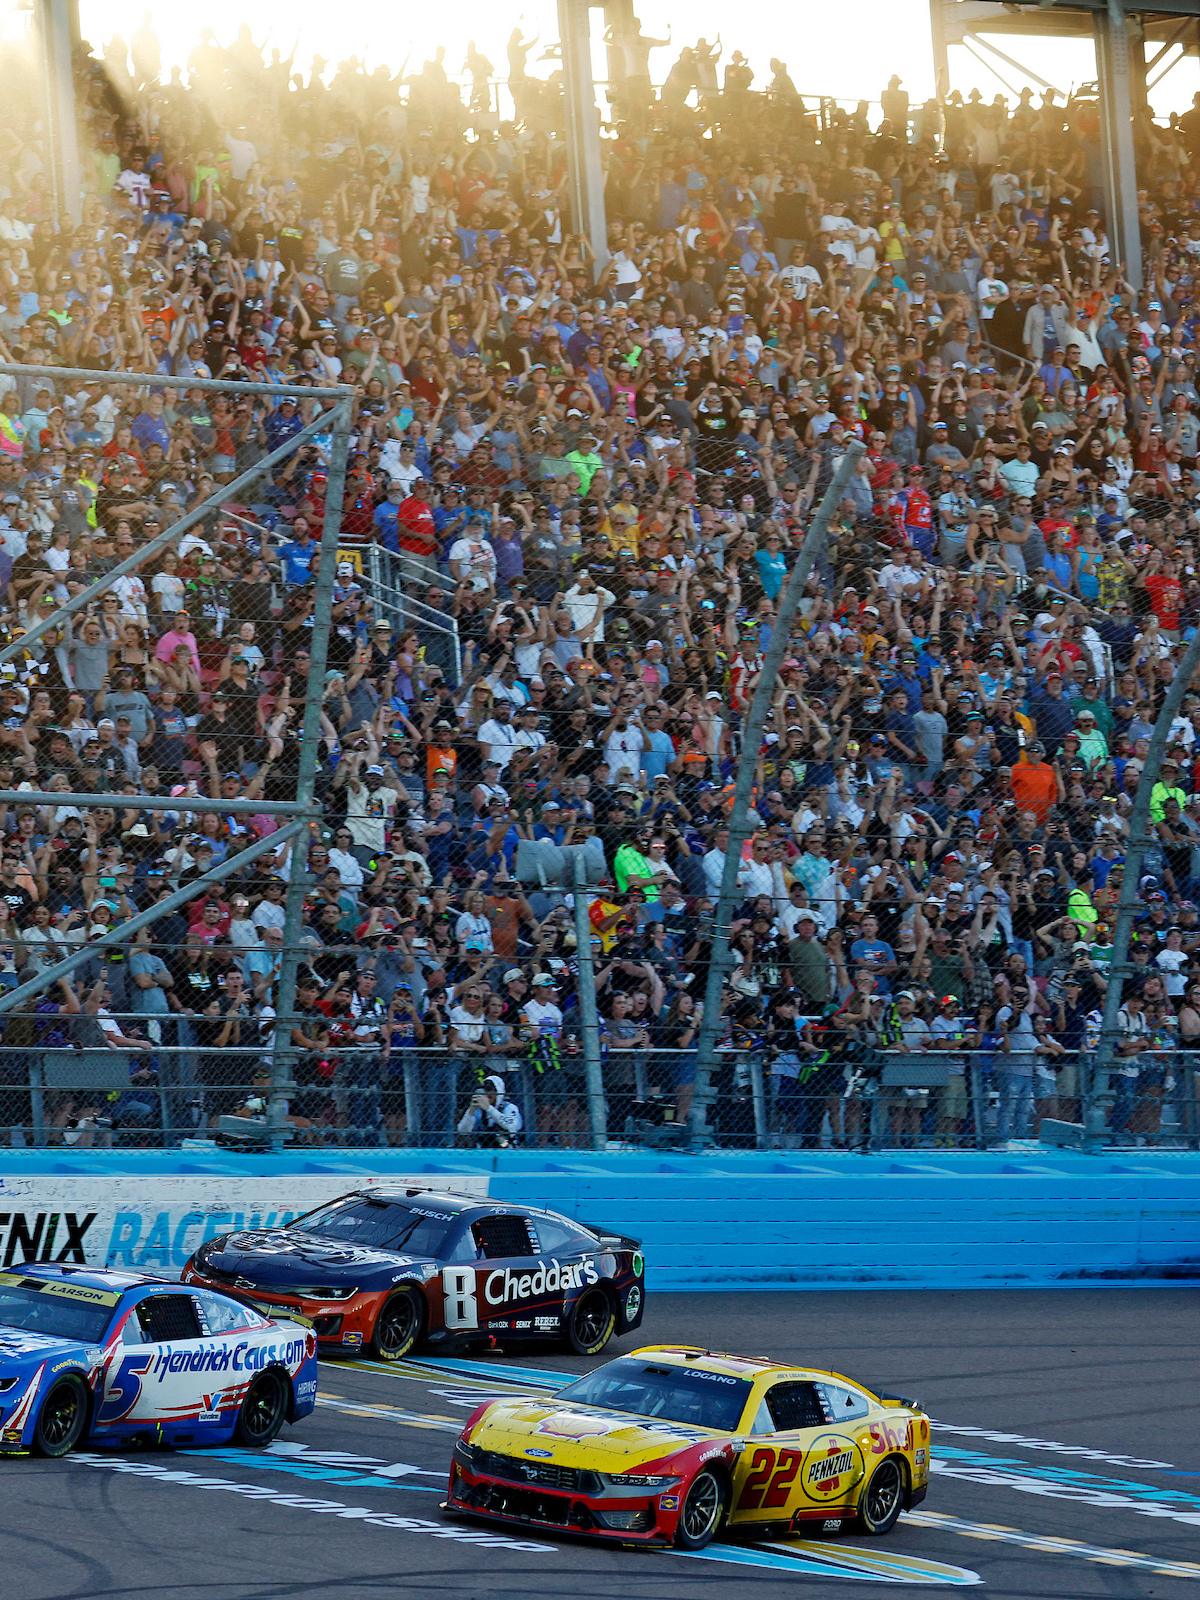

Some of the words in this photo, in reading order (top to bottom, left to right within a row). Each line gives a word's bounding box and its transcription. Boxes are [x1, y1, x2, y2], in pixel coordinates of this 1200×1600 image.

[409, 1207, 454, 1222] BUSCH
[391, 1270, 424, 1283] GOODYEAR
[485, 1254, 600, 1306] Cheddar's
[49, 1284, 104, 1300] LARSON
[442, 1265, 479, 1329] 8
[534, 1316, 560, 1326] REBEL
[98, 1353, 155, 1422] 5
[683, 1368, 738, 1386] LOGANO
[735, 1447, 803, 1509] 22
[807, 1451, 855, 1483] PENNZOIL
[63, 1452, 560, 1553] HAMPIONSHIP
[823, 1519, 842, 1528] FORD
